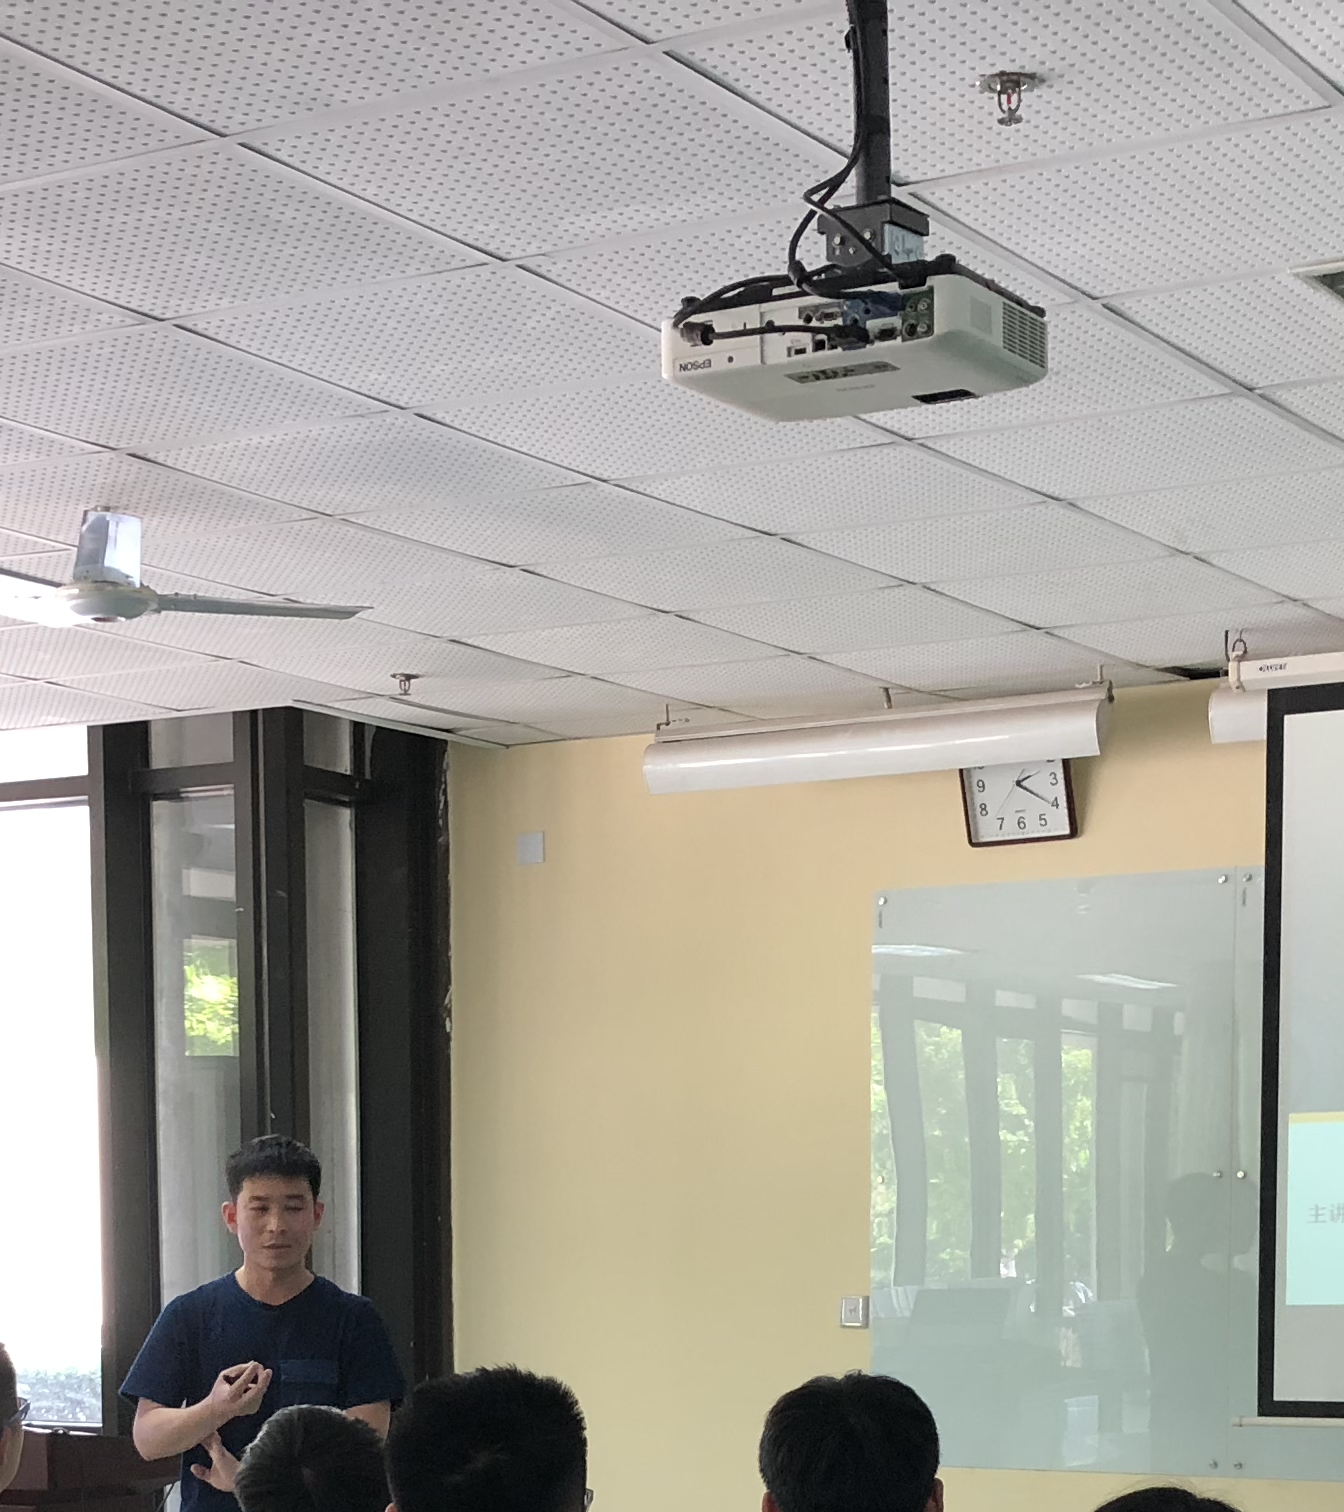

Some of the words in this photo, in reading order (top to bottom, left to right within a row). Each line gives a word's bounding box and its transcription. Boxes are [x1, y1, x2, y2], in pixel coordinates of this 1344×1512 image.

[678, 358, 712, 373] EPSON
[976, 779, 986, 793] 9
[1048, 771, 1059, 787] 3
[978, 802, 989, 817] 8
[1050, 796, 1060, 810] 4
[996, 817, 1005, 831] 7
[1016, 816, 1027, 830] 6
[1038, 813, 1048, 827] 5
